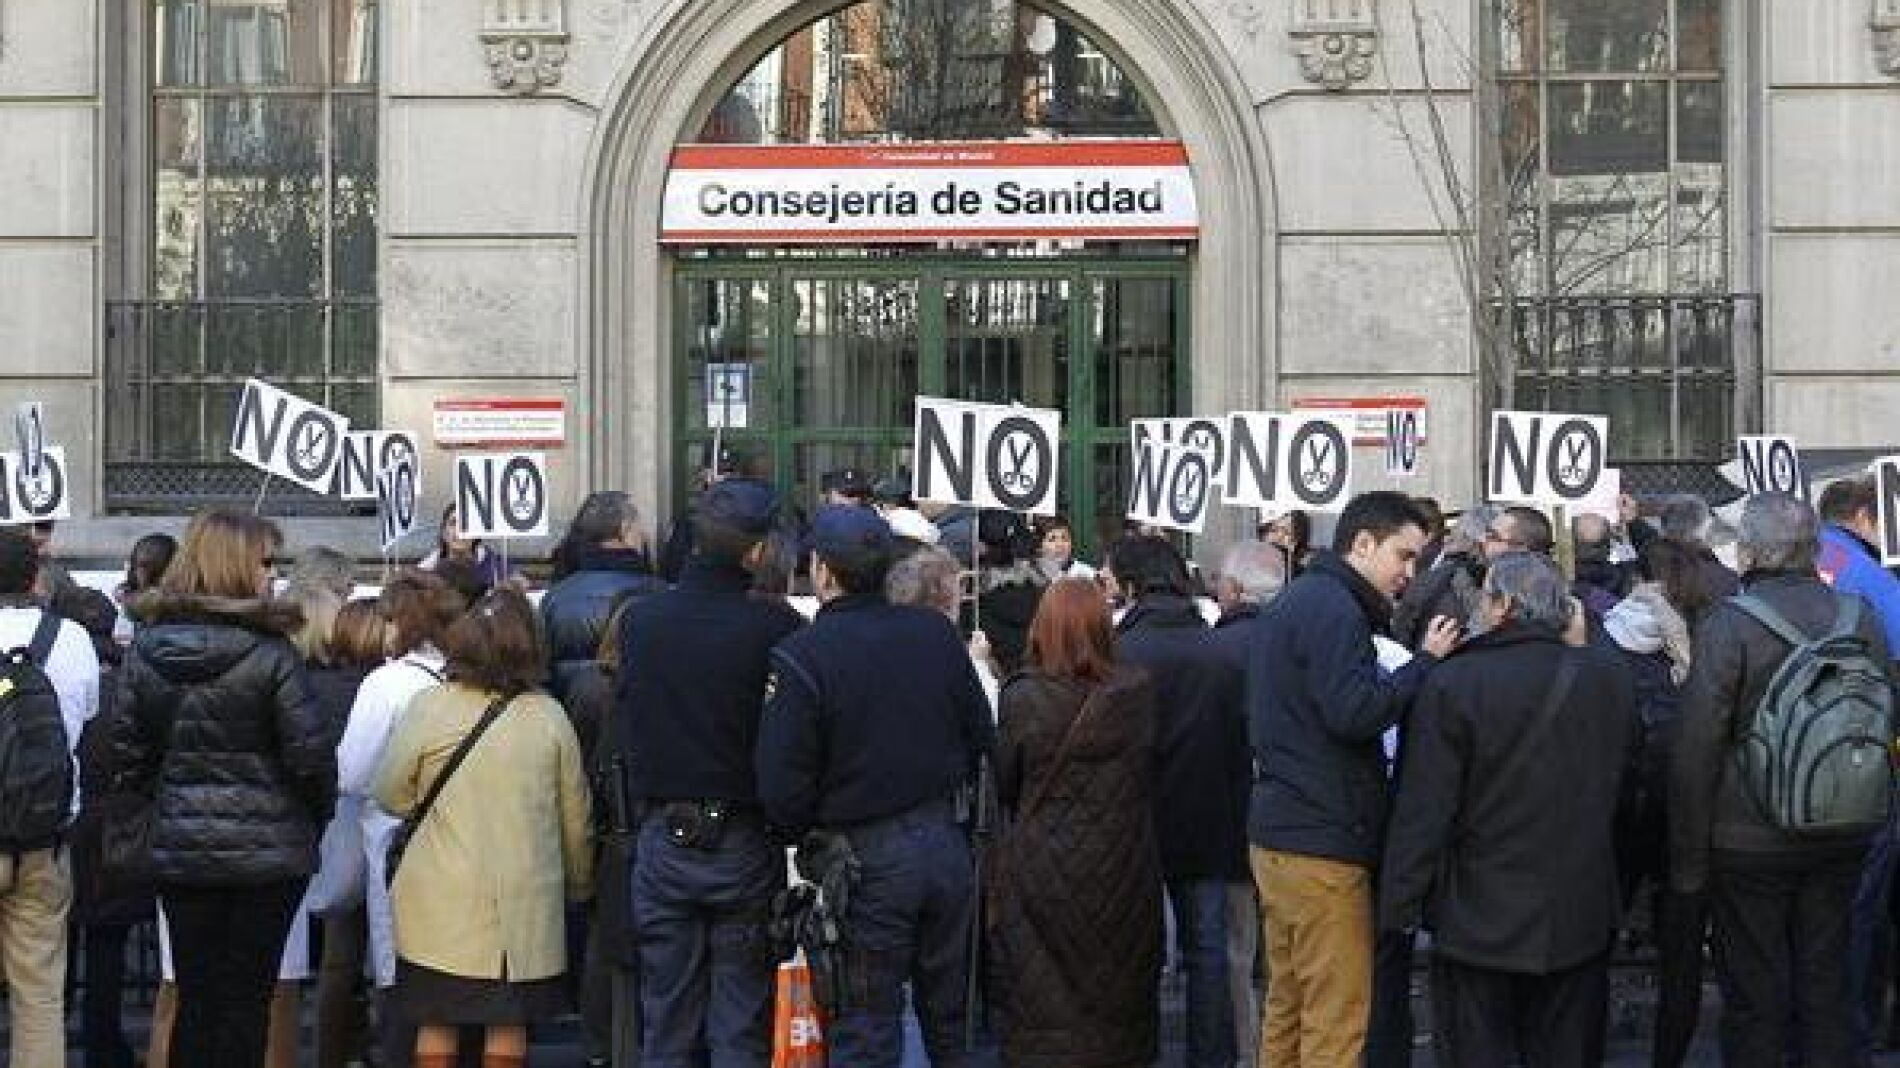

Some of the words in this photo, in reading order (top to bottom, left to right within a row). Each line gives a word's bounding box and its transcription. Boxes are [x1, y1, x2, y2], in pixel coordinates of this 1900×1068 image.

[698, 180, 917, 224] Consejería
[932, 183, 982, 215] de
[994, 178, 1162, 216] Sanidad
[236, 386, 339, 480] NO
[916, 407, 1052, 510] NO
[1227, 416, 1346, 505] NO
[1387, 411, 1415, 471] NO
[1494, 416, 1600, 499] NO
[1741, 440, 1796, 492] NO
[458, 457, 543, 531] NO
[1132, 445, 1206, 523] NO
